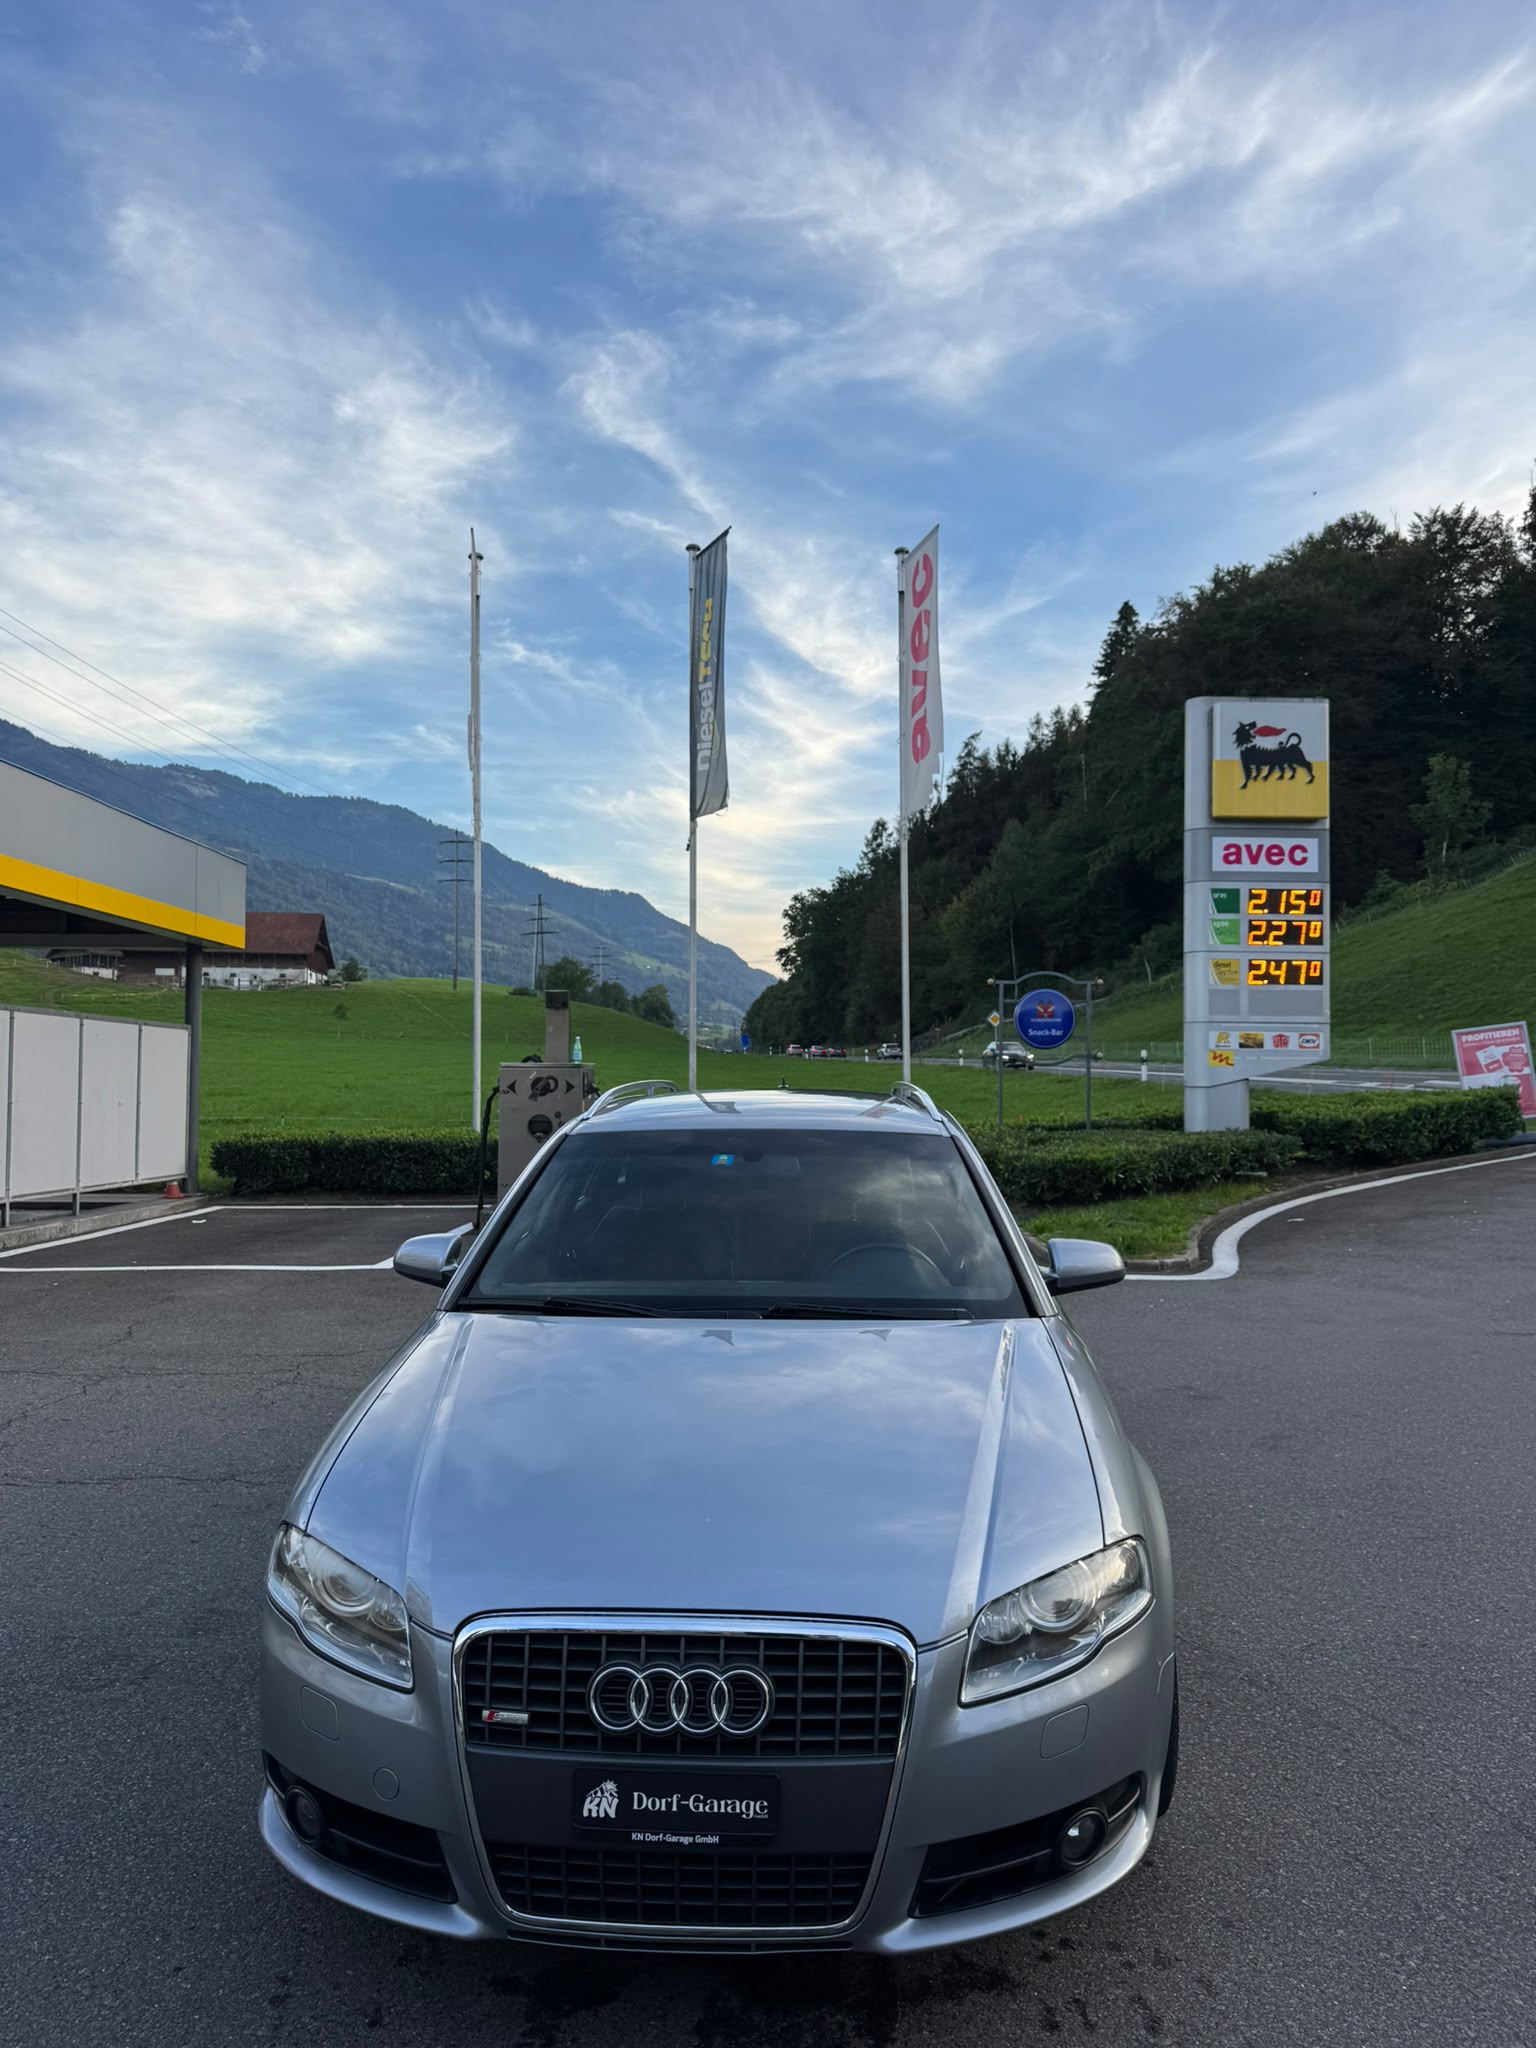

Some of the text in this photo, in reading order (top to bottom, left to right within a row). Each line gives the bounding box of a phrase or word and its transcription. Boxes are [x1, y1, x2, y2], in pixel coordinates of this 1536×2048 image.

[910, 553, 933, 765] avec
[1222, 843, 1308, 866] avec
[1028, 1028, 1063, 1036] Snack-Bar
[1461, 1028, 1520, 1042] PROFITIEREN
[583, 1791, 769, 1819] KN Dorf-Garage
[632, 1832, 720, 1845] KN Dorf-Garage GmbH
